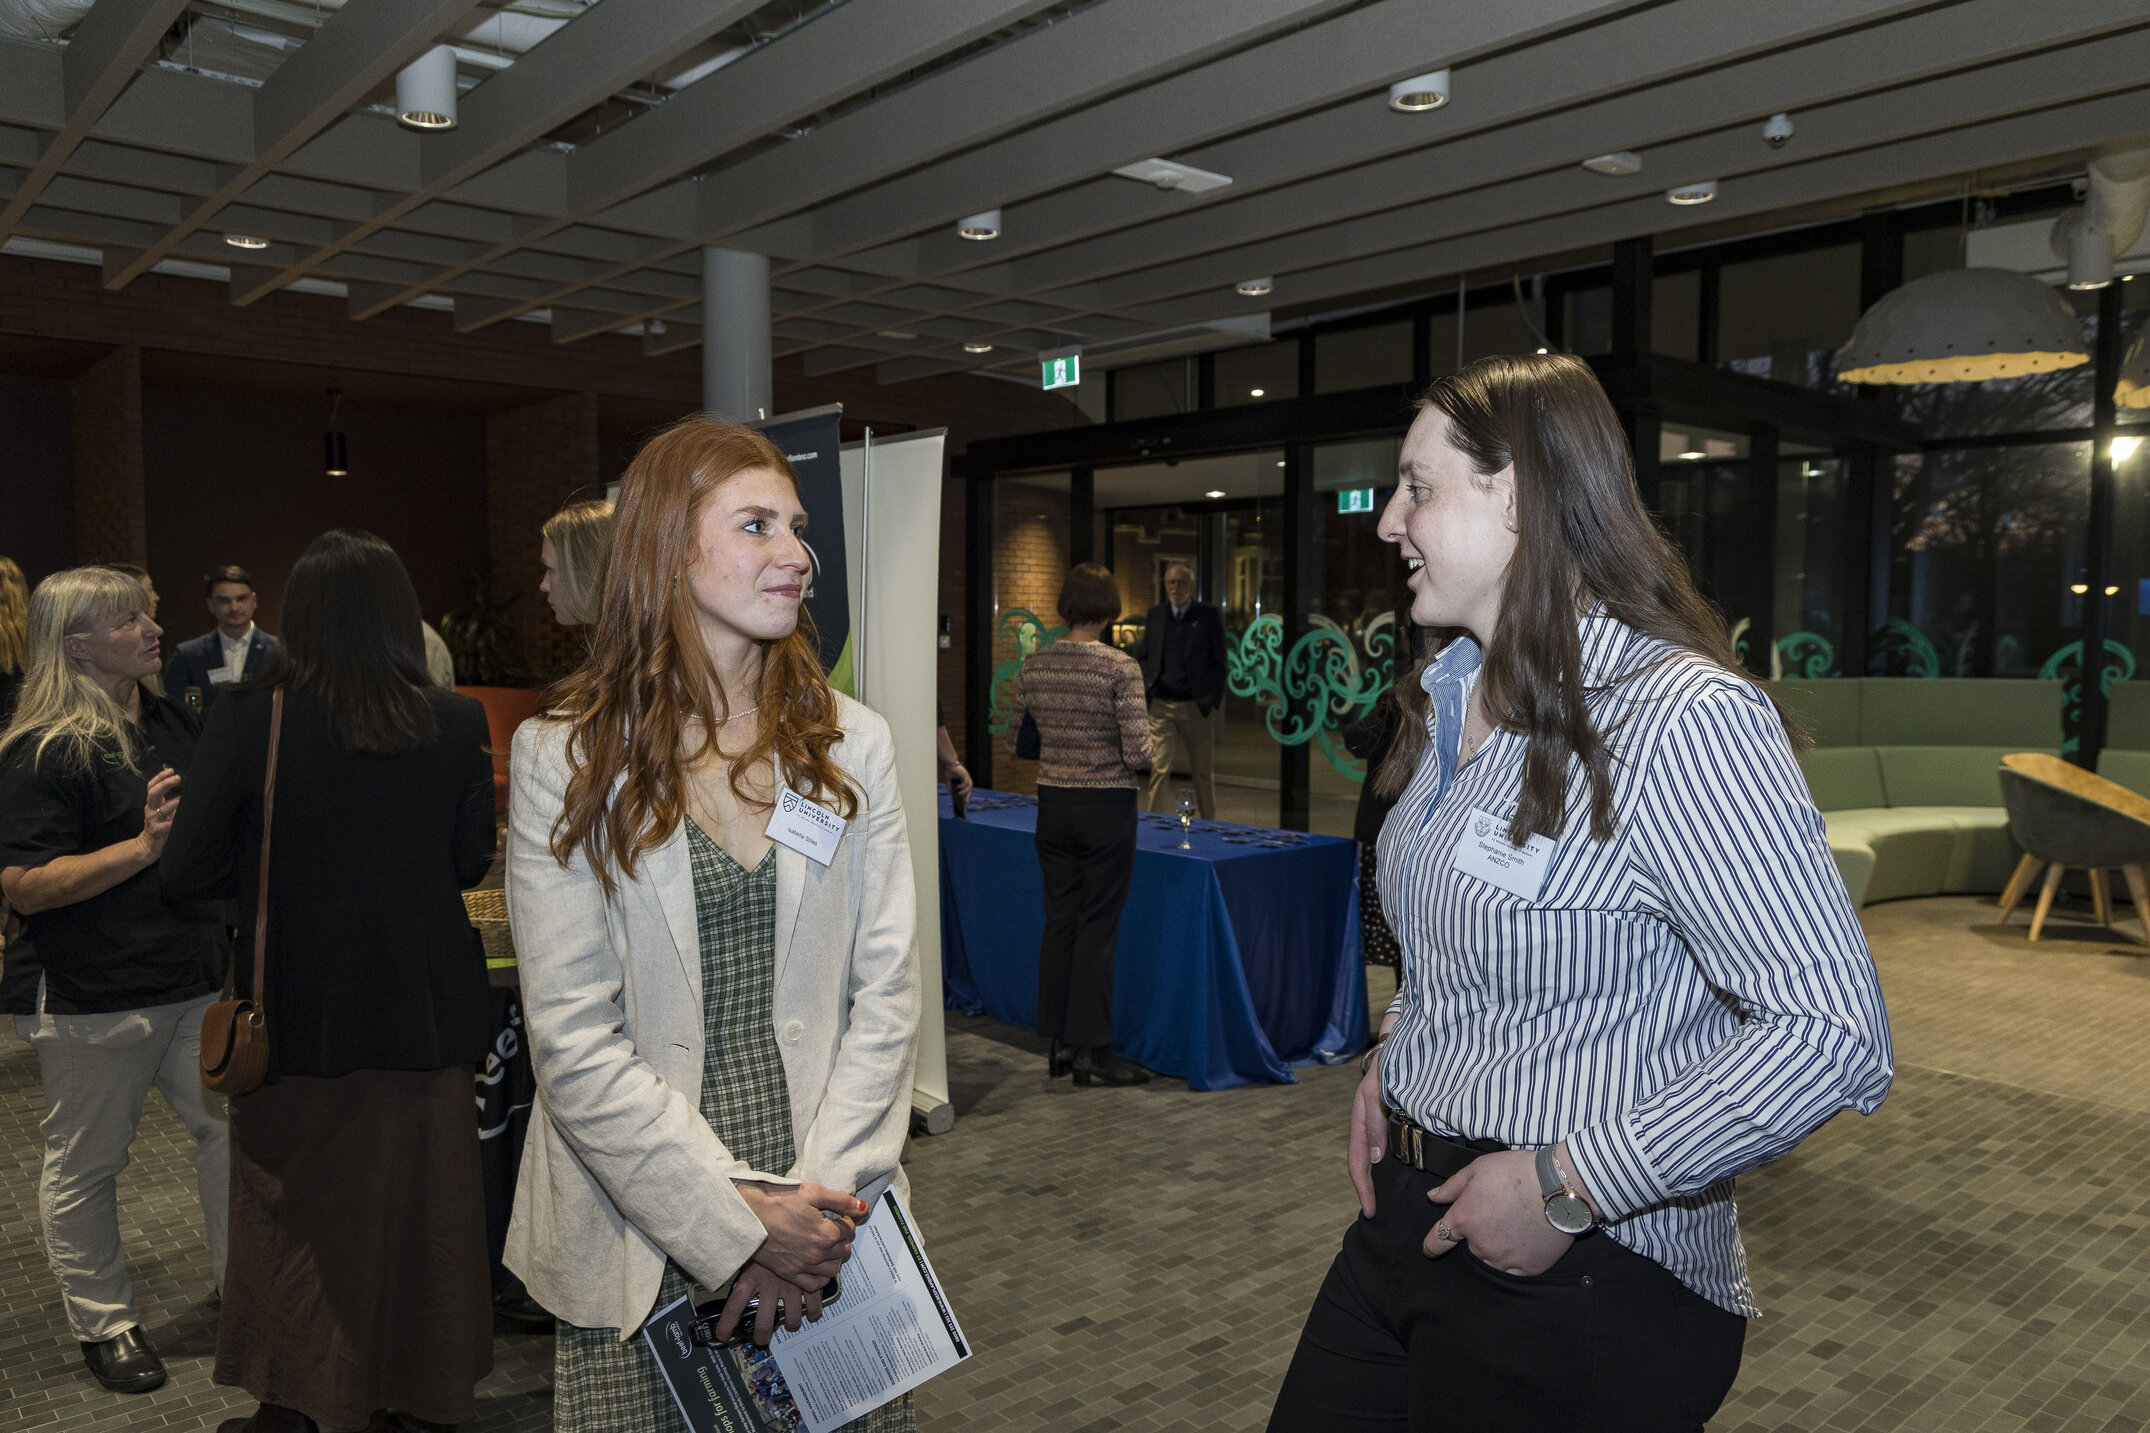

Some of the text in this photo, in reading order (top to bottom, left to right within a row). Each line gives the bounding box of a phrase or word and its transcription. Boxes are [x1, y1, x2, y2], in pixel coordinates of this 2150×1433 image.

[799, 808, 840, 831] UNIVERSITY
[801, 802, 829, 820] LINCOLN
[787, 827, 804, 839] Isabella
[1478, 842, 1507, 858] Stephanie
[1508, 854, 1525, 866] Smith
[1487, 855, 1510, 868] ANZCO
[697, 1366, 717, 1401] farming
[714, 1402, 727, 1416] for
